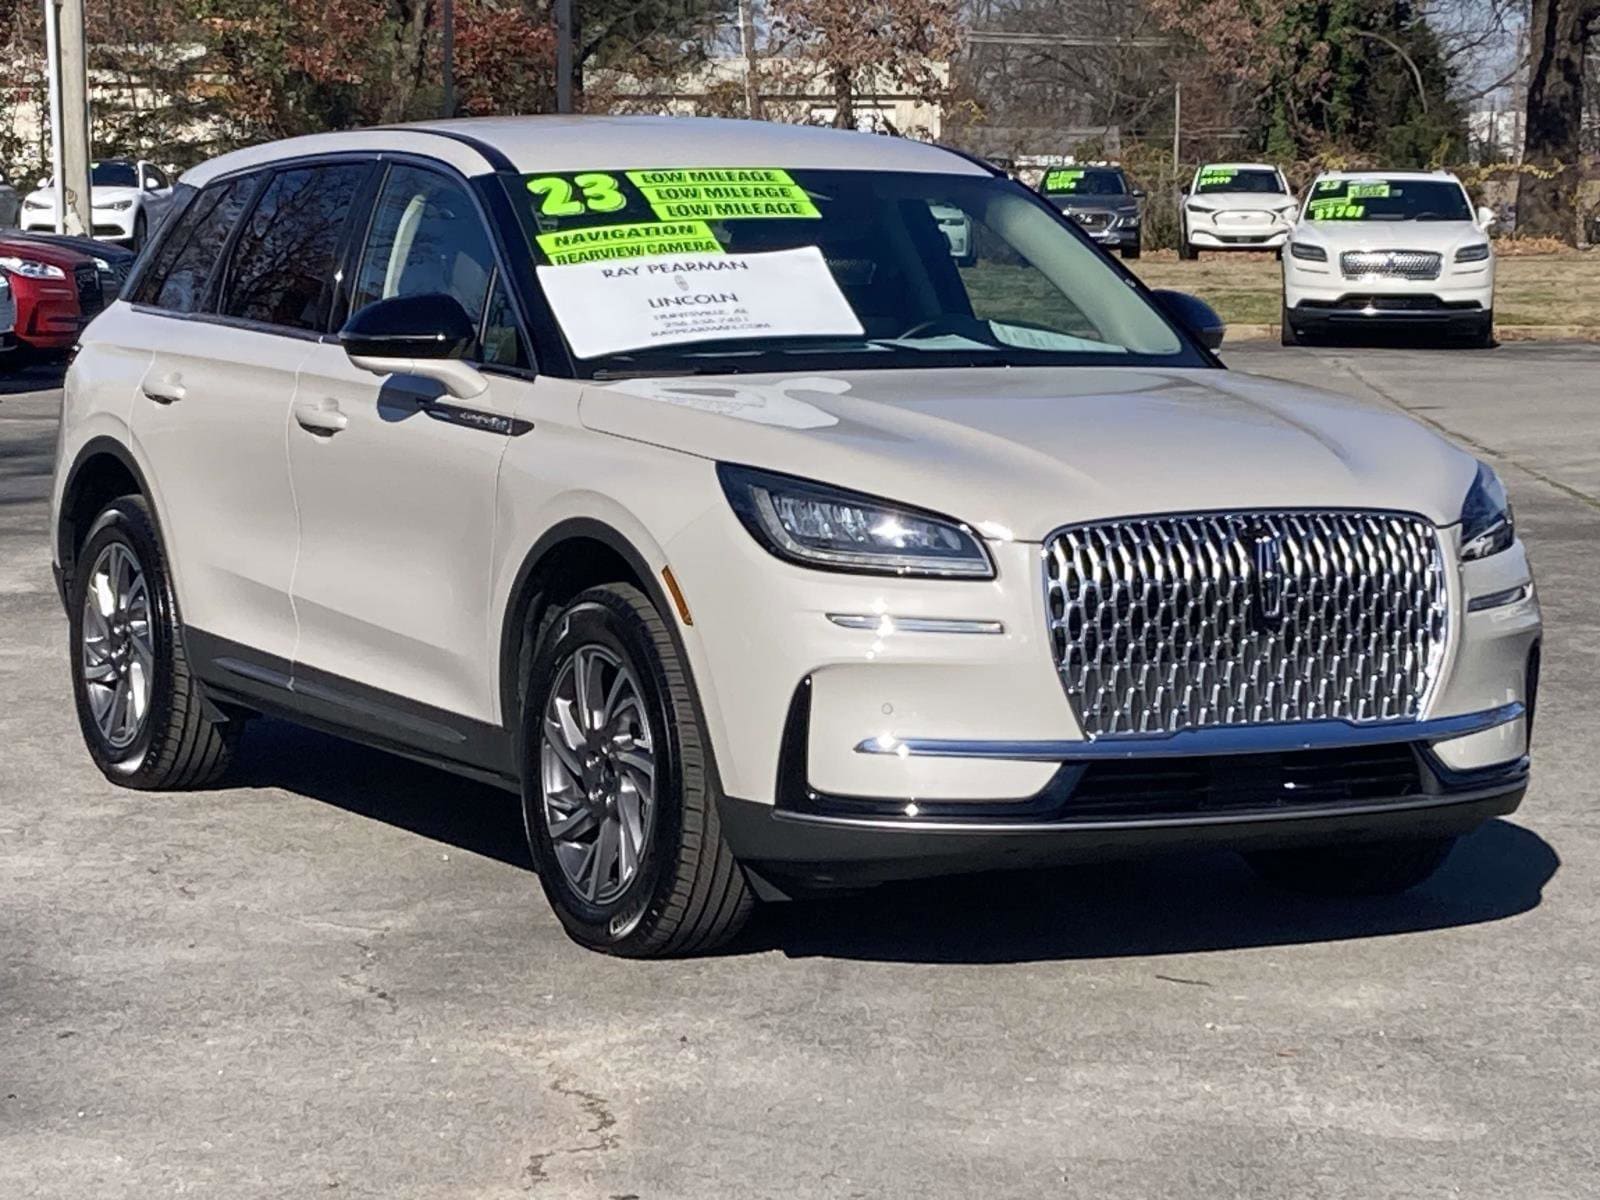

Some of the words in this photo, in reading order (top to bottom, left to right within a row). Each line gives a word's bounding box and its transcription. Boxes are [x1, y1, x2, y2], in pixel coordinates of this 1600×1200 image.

[641, 171, 685, 183] LOW
[689, 169, 777, 183] MILEAGE
[527, 174, 627, 215] 23
[655, 187, 700, 200] LOW
[703, 186, 795, 200] MILEAGE
[666, 203, 711, 217] LOW
[715, 201, 804, 216] MILEAGE
[554, 225, 698, 247] NAVIGATION
[556, 246, 643, 265] REARVIEW
[645, 241, 717, 255] CAMERA
[602, 266, 639, 278] RAY
[648, 260, 749, 274] PEARMAN
[648, 292, 739, 309] LINCOLN
